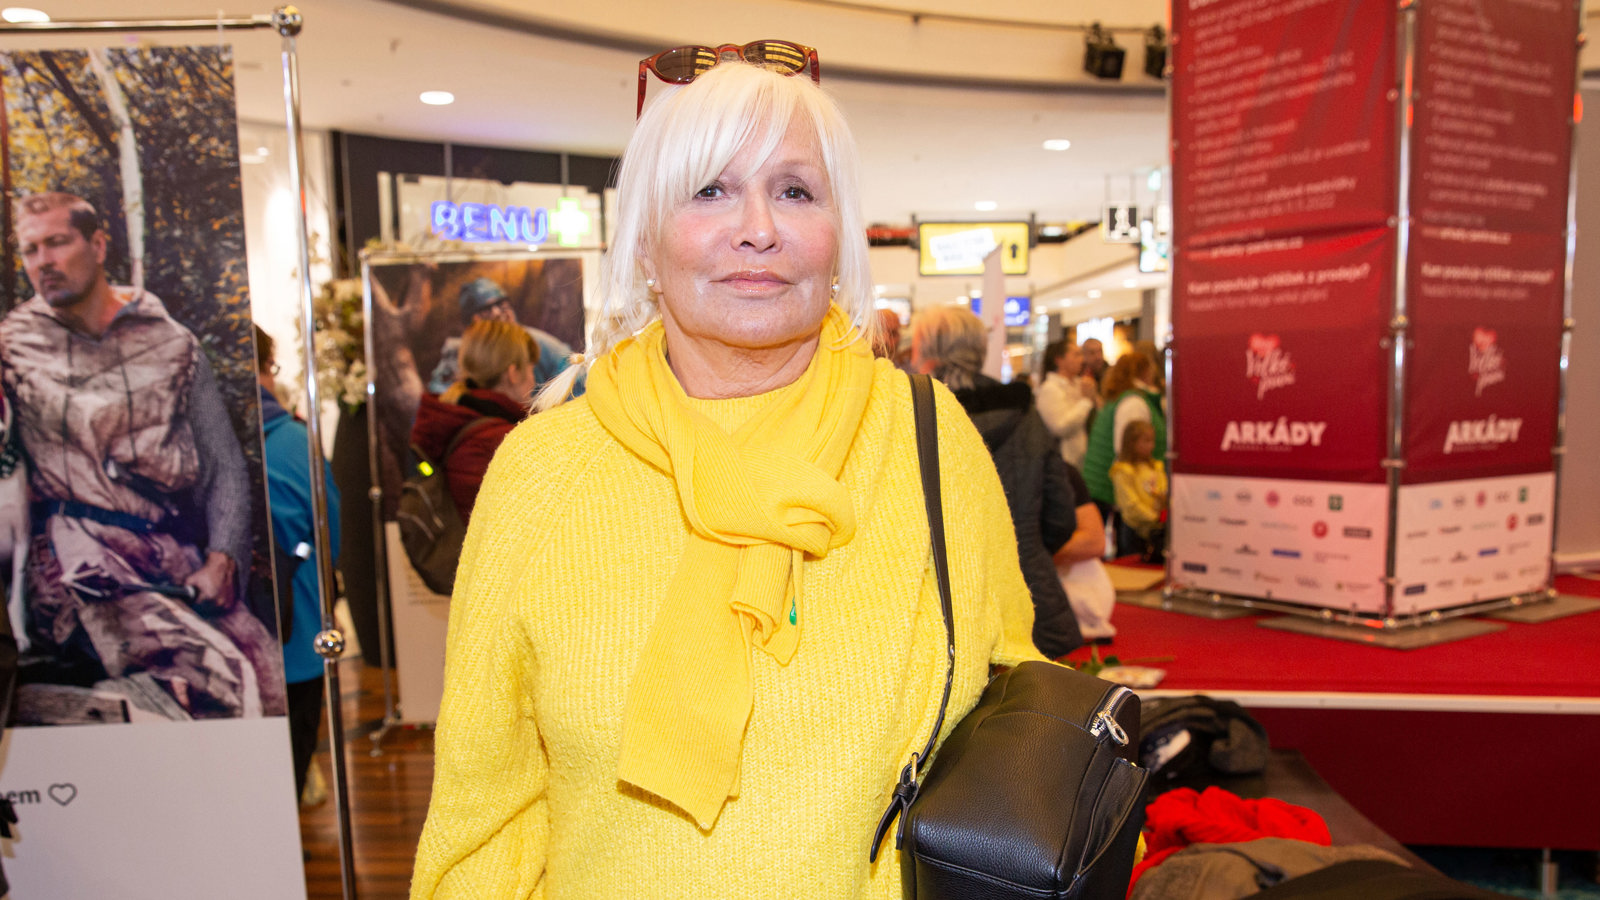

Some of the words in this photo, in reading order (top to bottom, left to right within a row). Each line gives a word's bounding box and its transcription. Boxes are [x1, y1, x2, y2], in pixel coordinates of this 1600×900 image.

[431, 200, 548, 244] BENU
[1220, 416, 1327, 451] ARKÁDY
[1443, 413, 1523, 454] ARKÁDY
